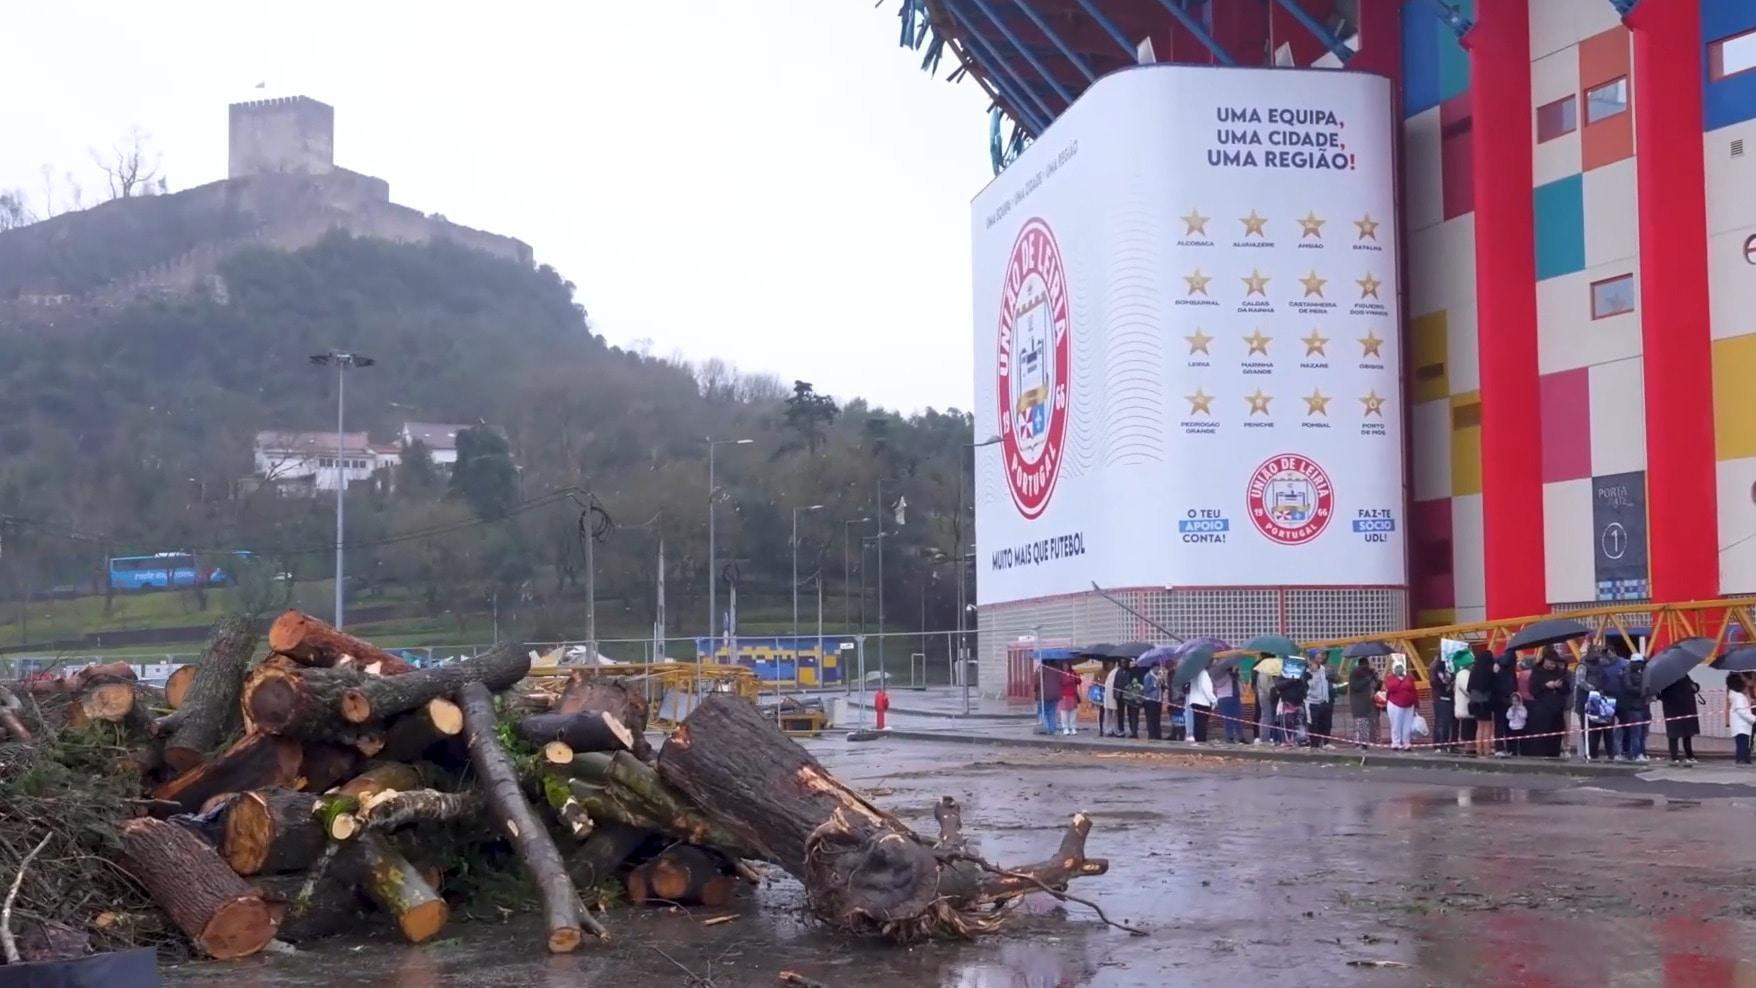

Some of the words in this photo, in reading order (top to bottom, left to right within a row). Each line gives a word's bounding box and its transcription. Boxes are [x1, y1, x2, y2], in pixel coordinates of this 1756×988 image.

[1217, 107, 1262, 123] UMA
[1268, 108, 1345, 129] EQUIPA,
[1217, 129, 1262, 146] UMA
[1268, 131, 1345, 151] CIDADE,
[1207, 150, 1258, 167] UMA
[1265, 148, 1355, 170] REGIÃO!
[1021, 233, 1035, 276] DE
[1038, 235, 1066, 347] LEIRIA
[1011, 441, 1056, 497] PORTUGAL
[1280, 458, 1296, 470] DE
[1299, 461, 1329, 498] LEIRIA
[1187, 509, 1197, 518] O
[1200, 509, 1221, 518] TEU
[1318, 508, 1328, 517] 66
[1358, 509, 1391, 518] FAZ-TE
[1184, 521, 1224, 531] APOIO
[1265, 522, 1318, 539] PORTUGAL
[1182, 534, 1226, 543] CONTA!
[1364, 533, 1388, 542] UDL!
[992, 547, 1013, 571] MUITO
[1014, 543, 1032, 567] MAIS
[1033, 539, 1049, 566] QUE
[1050, 531, 1085, 560] FUTEBOL
